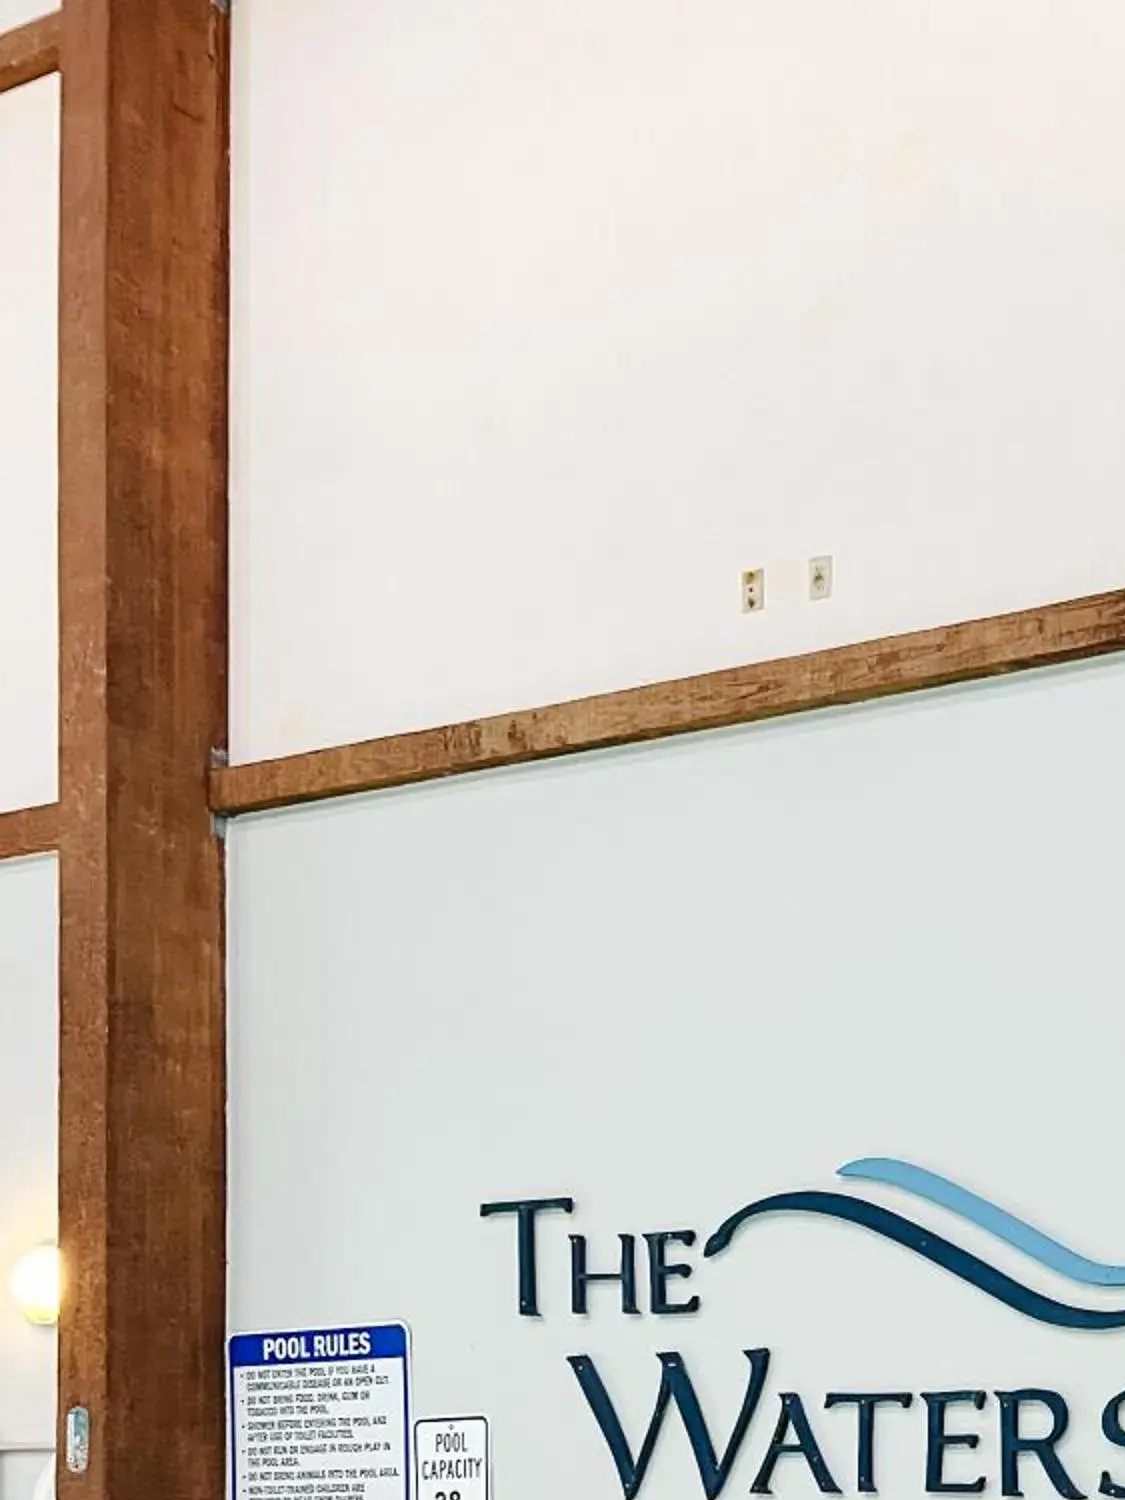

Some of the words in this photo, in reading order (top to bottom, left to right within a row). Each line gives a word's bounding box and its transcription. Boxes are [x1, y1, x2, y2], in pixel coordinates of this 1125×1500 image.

[263, 1337, 310, 1361] POOL
[314, 1333, 370, 1357] RULES
[435, 1433, 468, 1453] POOL
[421, 1459, 482, 1480] CAPACITY
